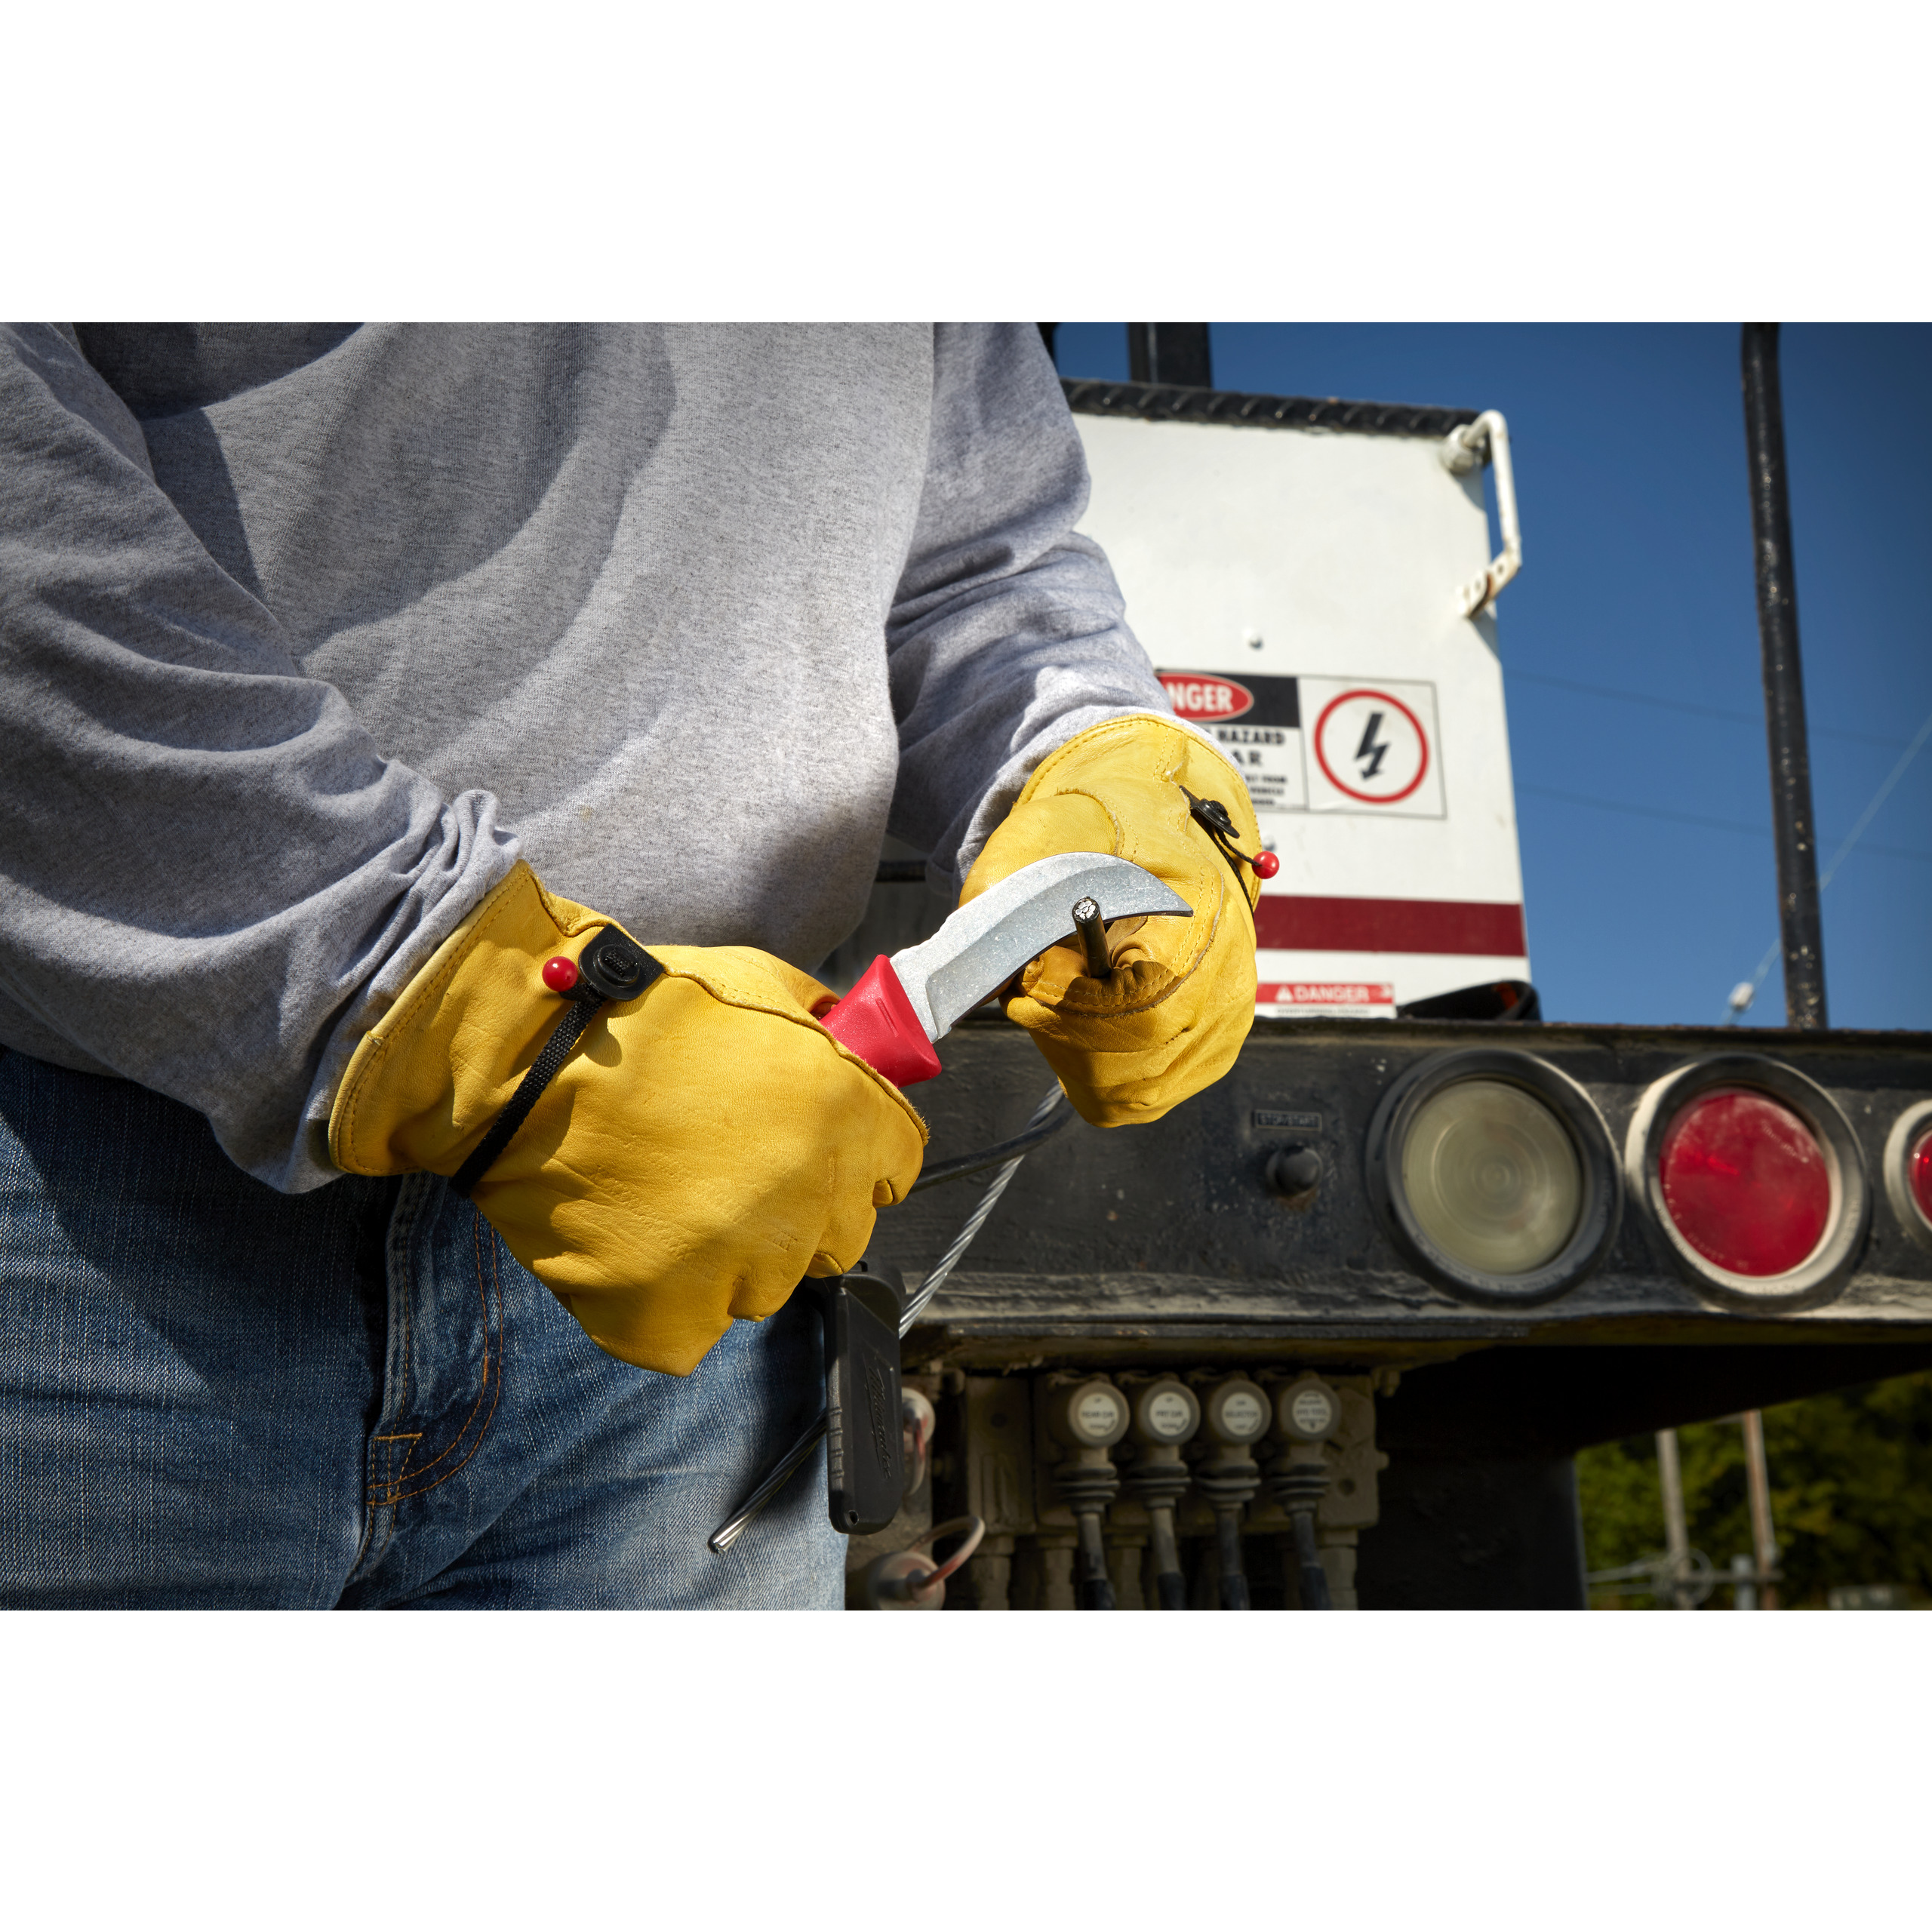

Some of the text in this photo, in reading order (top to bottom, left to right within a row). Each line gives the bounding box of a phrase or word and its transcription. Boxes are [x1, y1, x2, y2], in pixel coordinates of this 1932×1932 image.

[1166, 682, 1233, 712] NGER
[1218, 729, 1285, 745] HAZARD
[1293, 985, 1371, 1002] DANGER
[868, 1366, 891, 1479] Milwaukee
